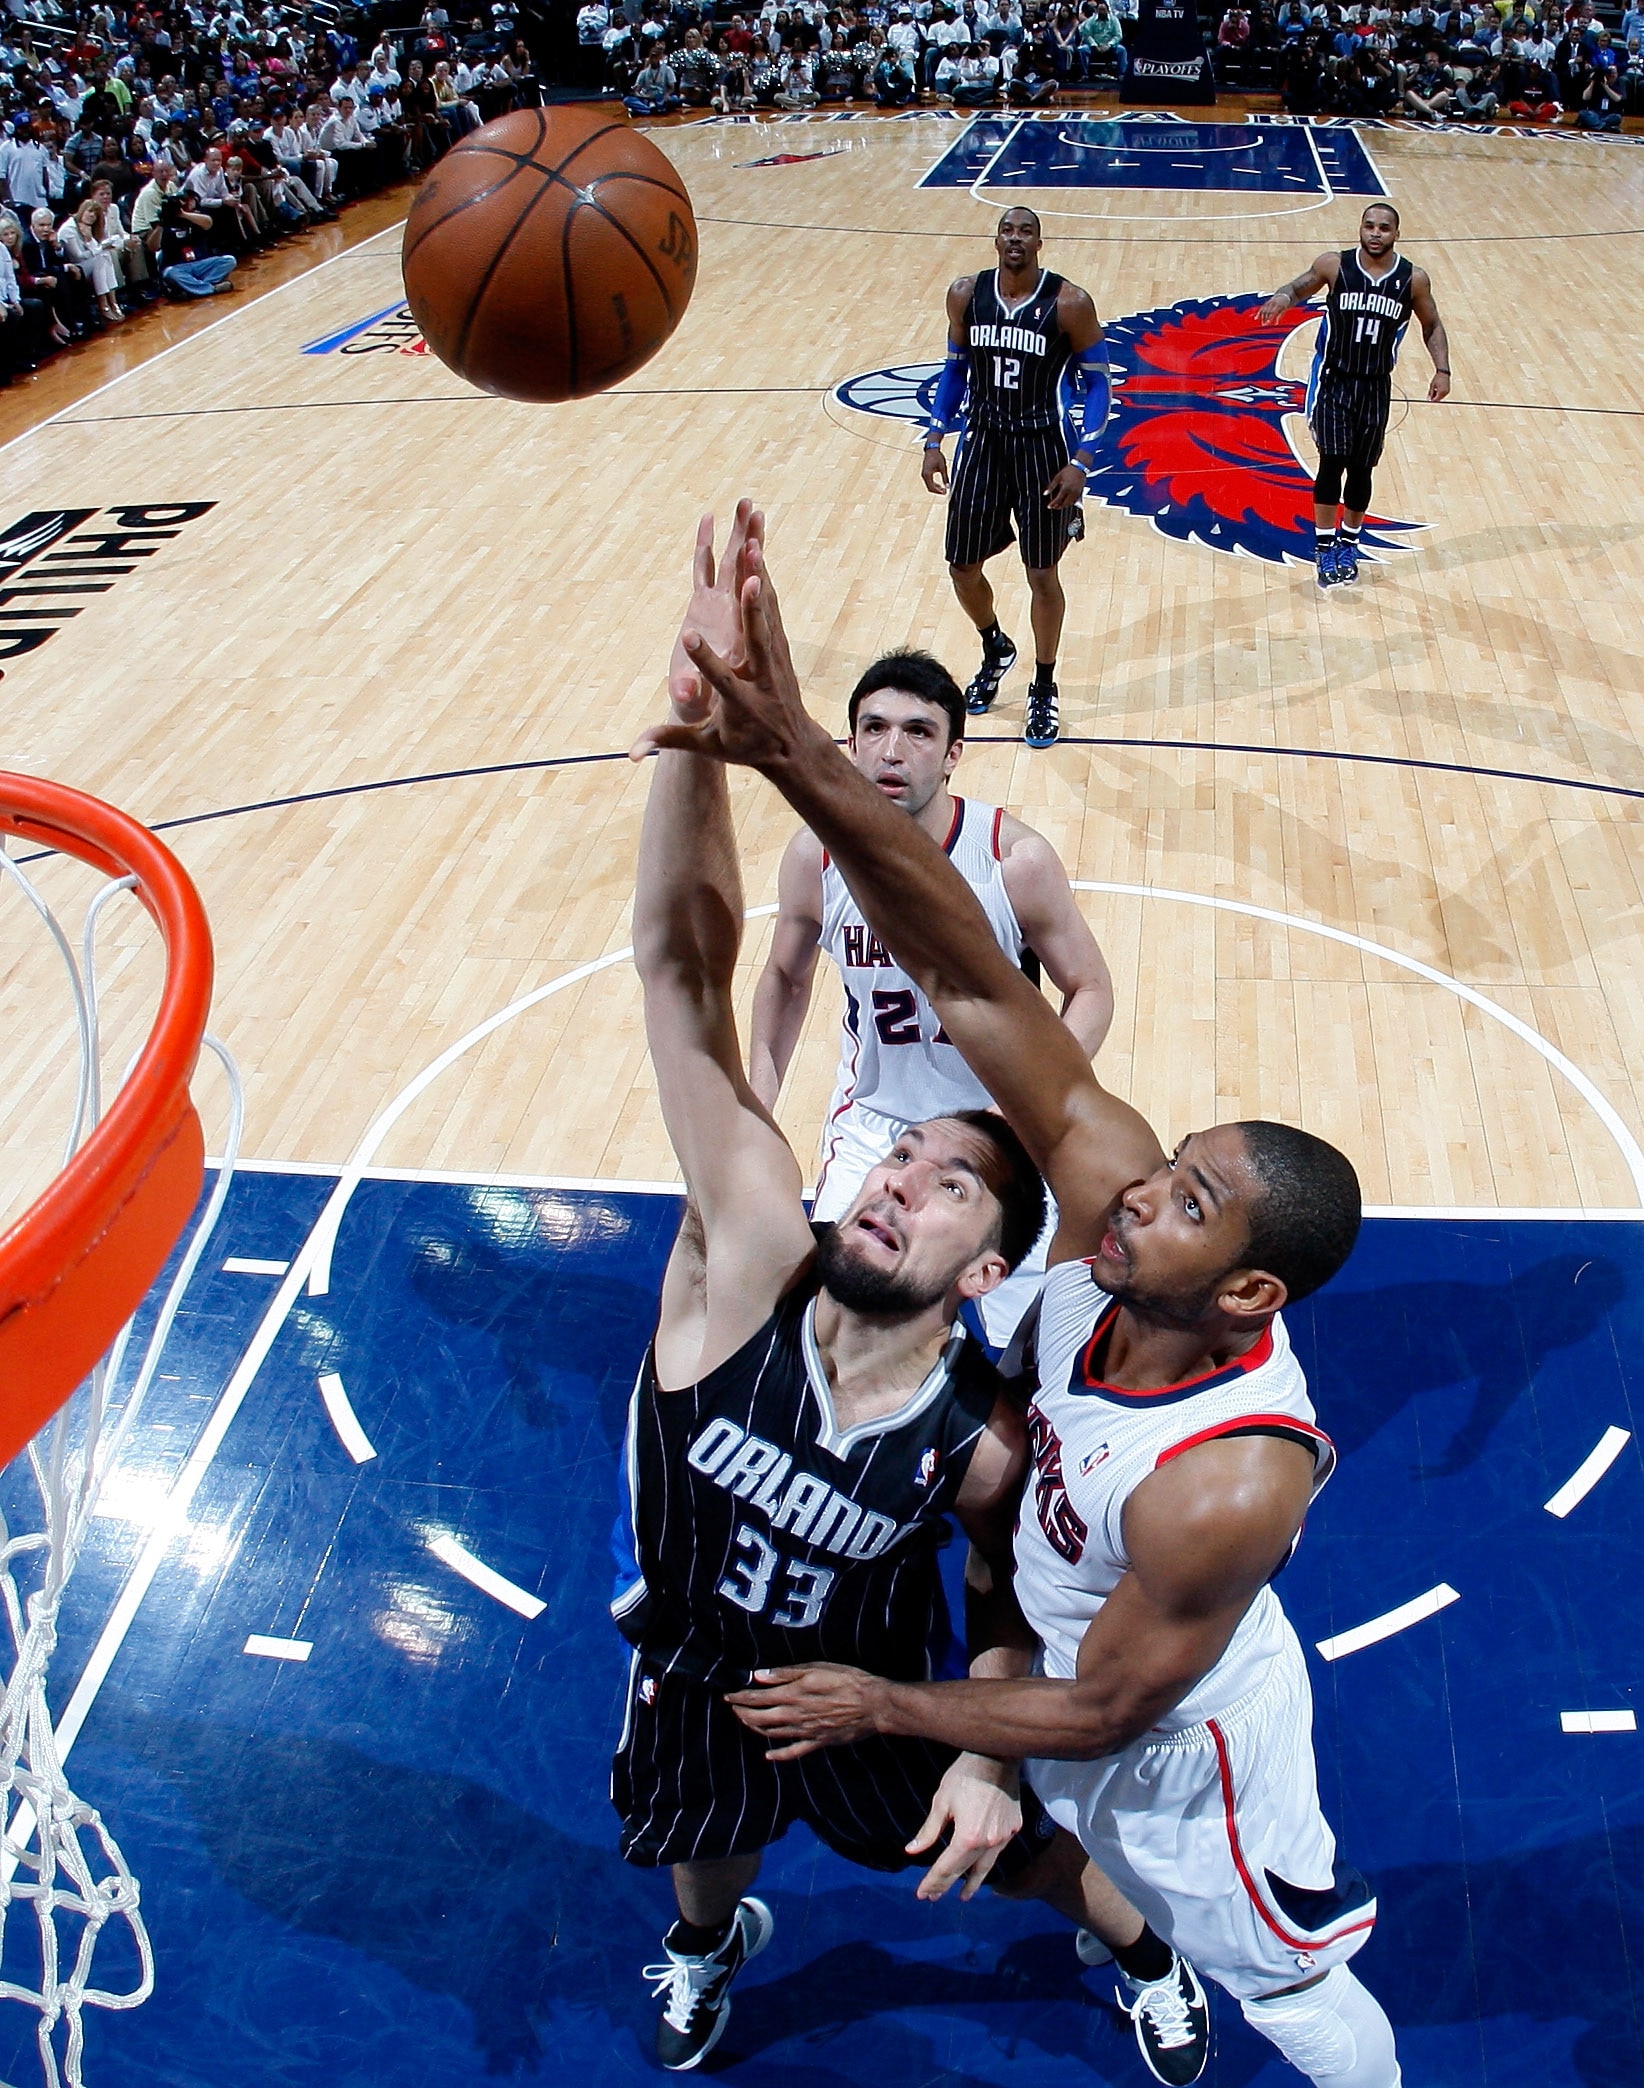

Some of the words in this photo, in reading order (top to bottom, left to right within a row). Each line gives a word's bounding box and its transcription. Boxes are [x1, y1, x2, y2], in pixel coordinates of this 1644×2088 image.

[1155, 9, 1172, 19] NBA
[1173, 9, 1185, 19] TV
[1142, 63, 1202, 75] PLAYOFFS
[1340, 292, 1403, 320] ORLANDO
[970, 325, 1046, 356] ORLANDO
[1355, 317, 1380, 344] 14
[993, 356, 1021, 389] 12
[0, 501, 220, 682] PHILIP
[1026, 1404, 1089, 1566] WKS
[717, 1524, 836, 1629] 33
